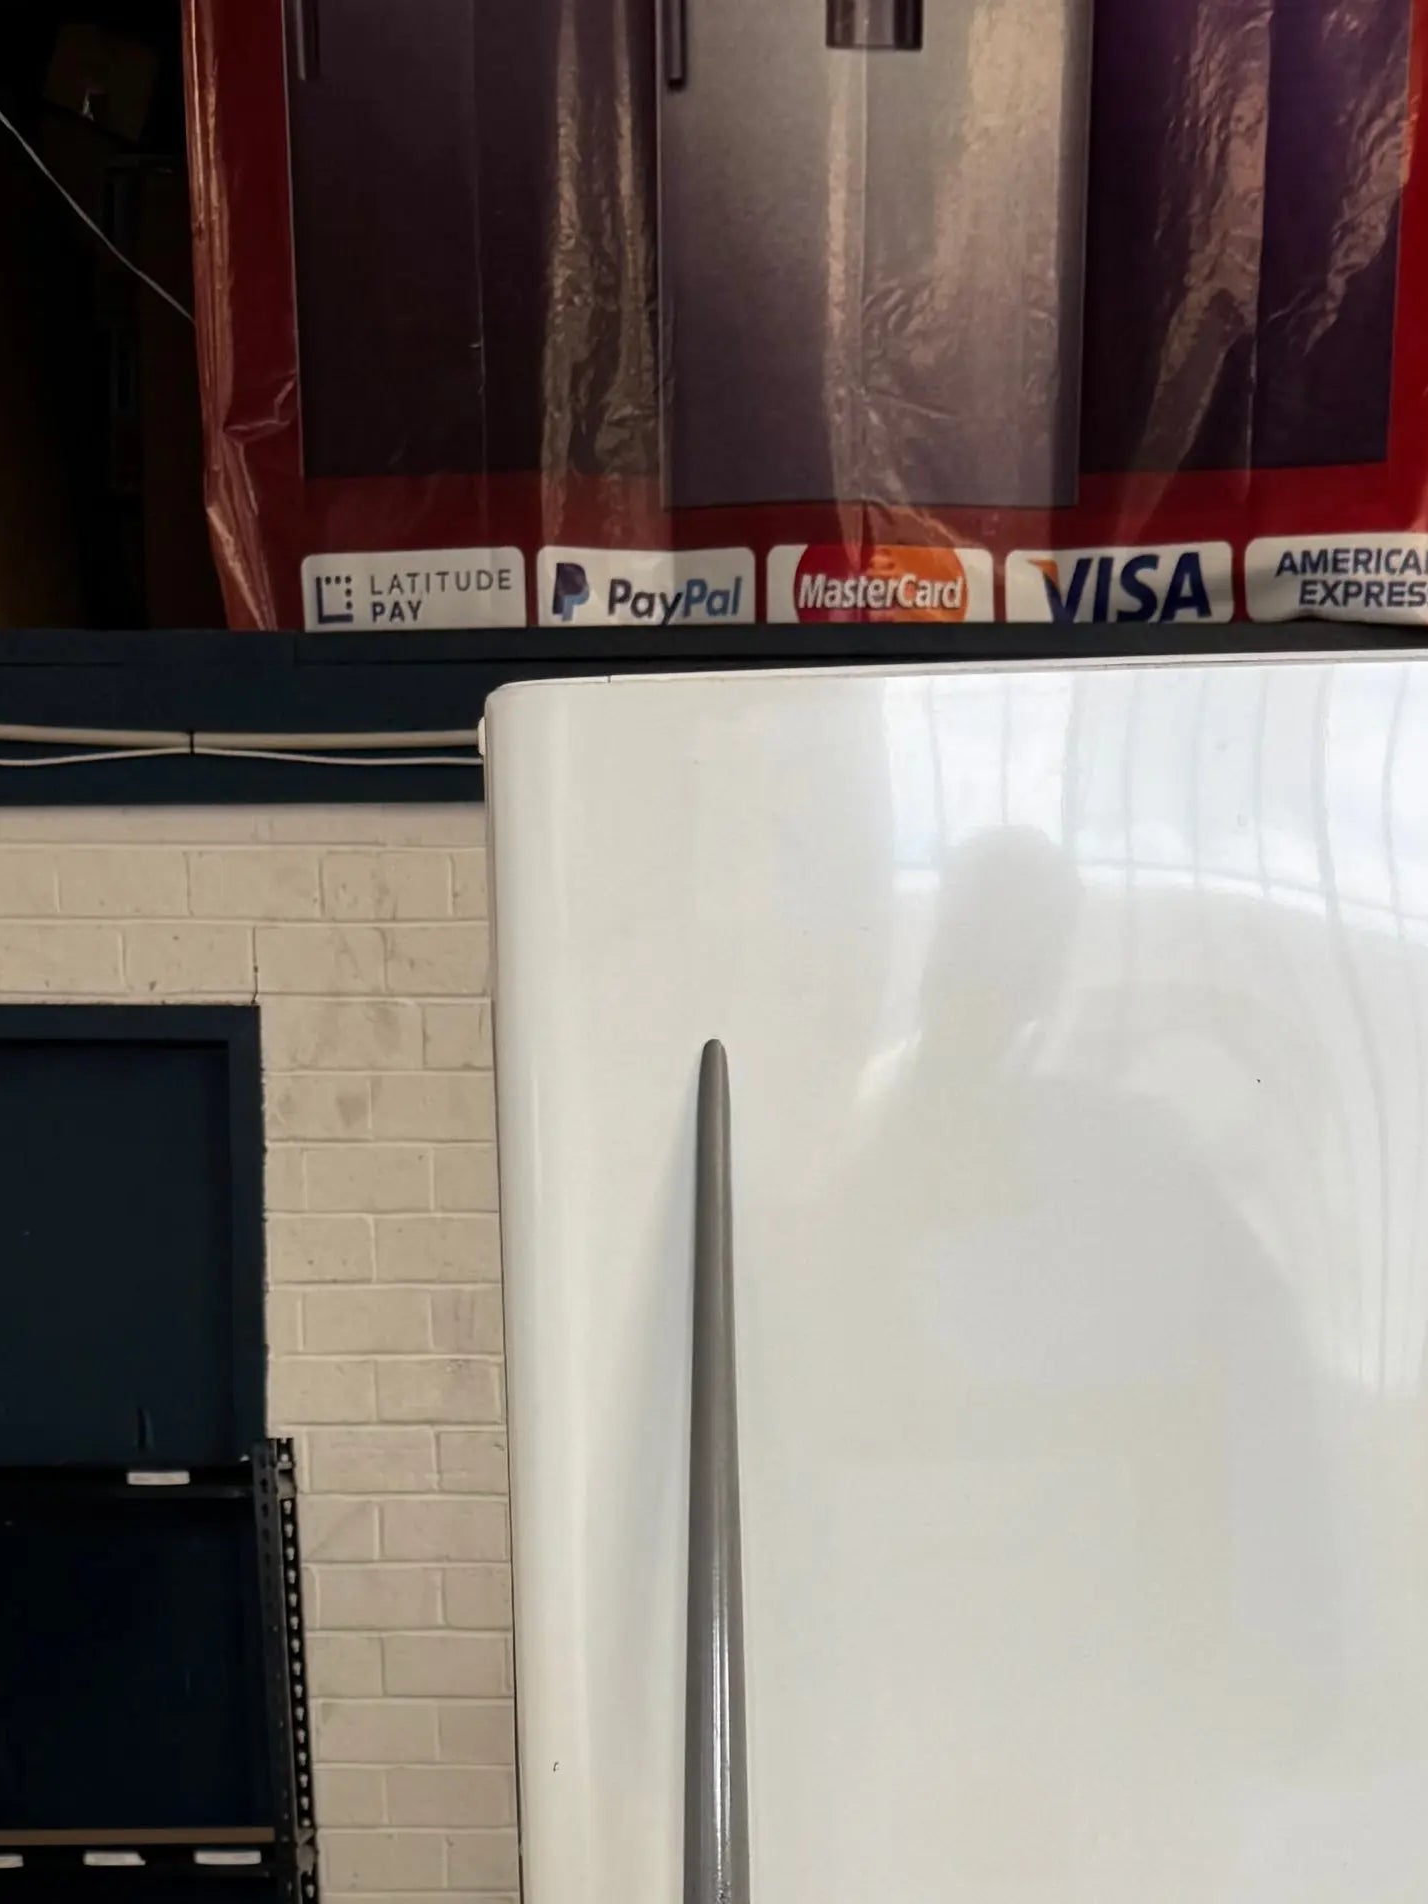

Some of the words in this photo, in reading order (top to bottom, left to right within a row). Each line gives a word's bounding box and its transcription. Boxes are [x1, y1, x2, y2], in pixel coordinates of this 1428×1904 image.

[371, 567, 512, 596] LATITUDE
[607, 576, 740, 625] PayPal
[798, 572, 965, 611] MasterCard
[1025, 552, 1213, 623] VISA
[372, 602, 423, 623] PAY
